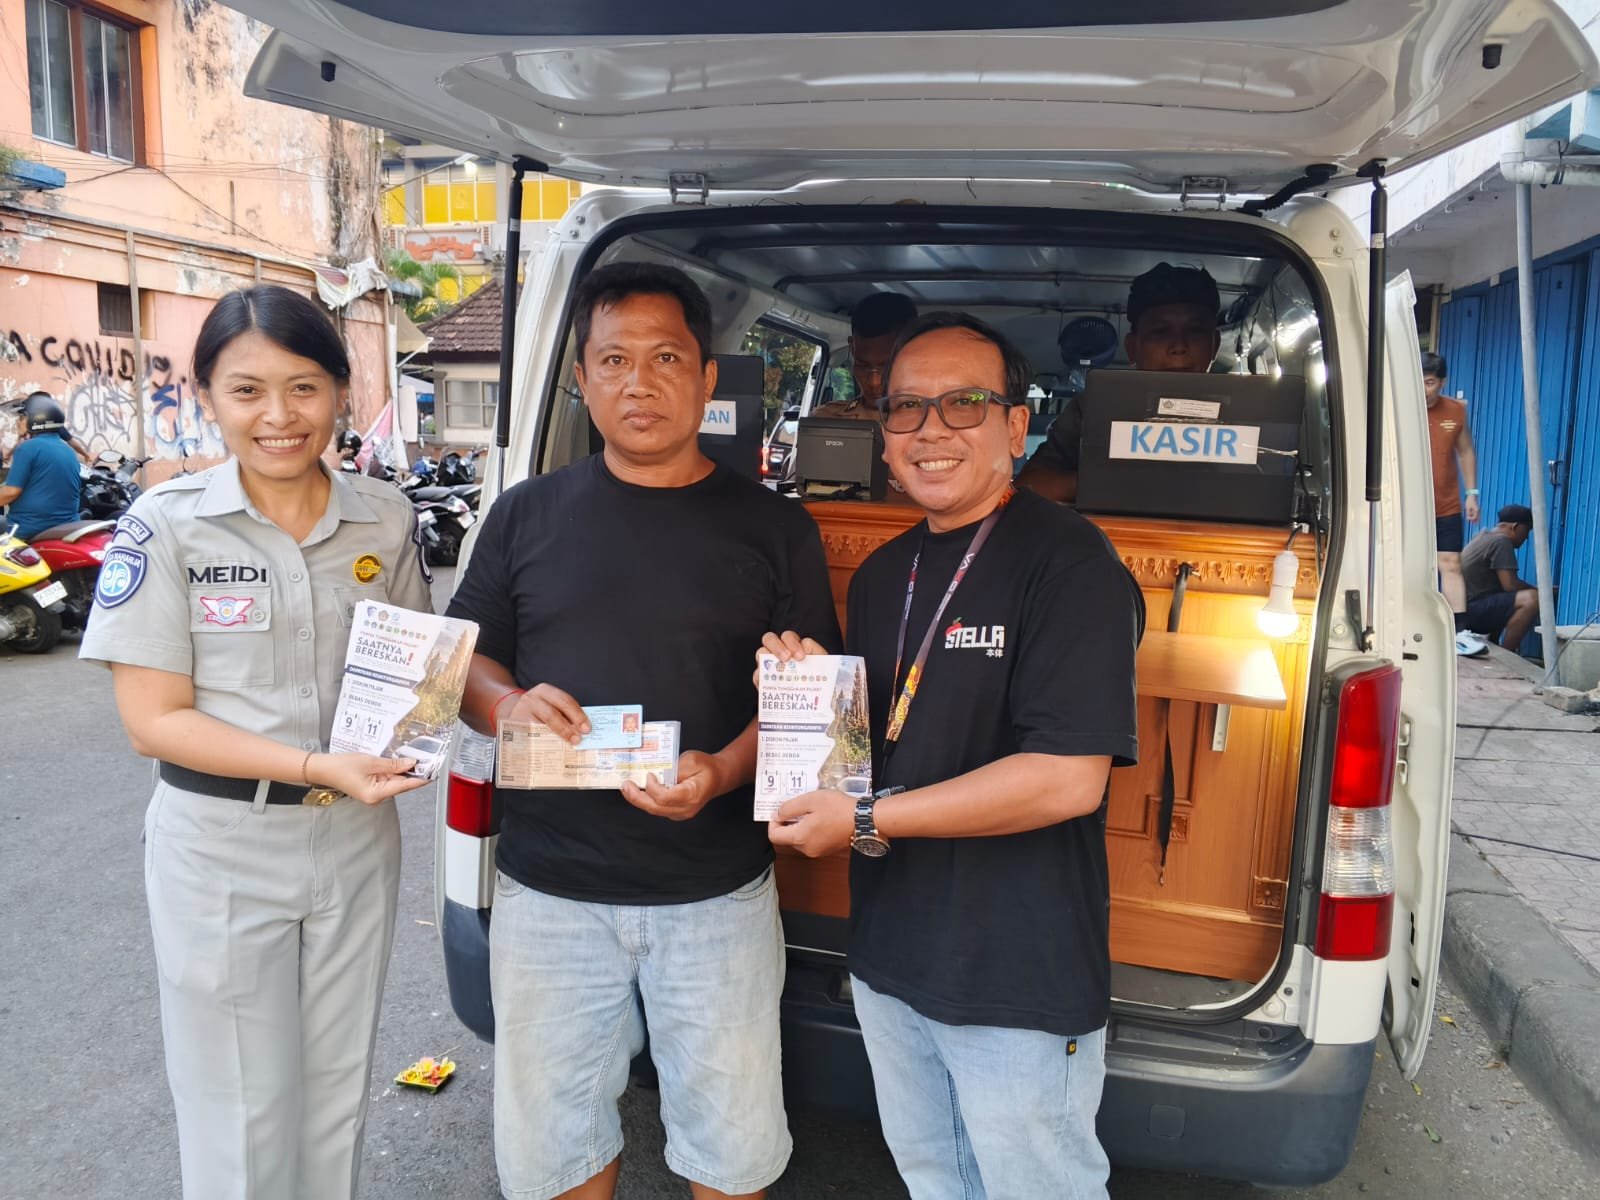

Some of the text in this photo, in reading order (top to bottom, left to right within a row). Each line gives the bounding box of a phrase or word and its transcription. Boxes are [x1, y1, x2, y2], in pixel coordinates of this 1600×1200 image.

[40, 336, 136, 381] COVID
[1130, 424, 1237, 457] KASIR
[187, 565, 267, 584] MEIDI
[357, 636, 402, 656] SAATNYA
[945, 625, 1005, 649] STELLA
[355, 645, 414, 666] BERESKAN!
[762, 691, 807, 702] SAATNYA
[762, 696, 819, 711] BERESKAN!
[345, 716, 378, 736] 9 11
[767, 775, 802, 788] 9 11
